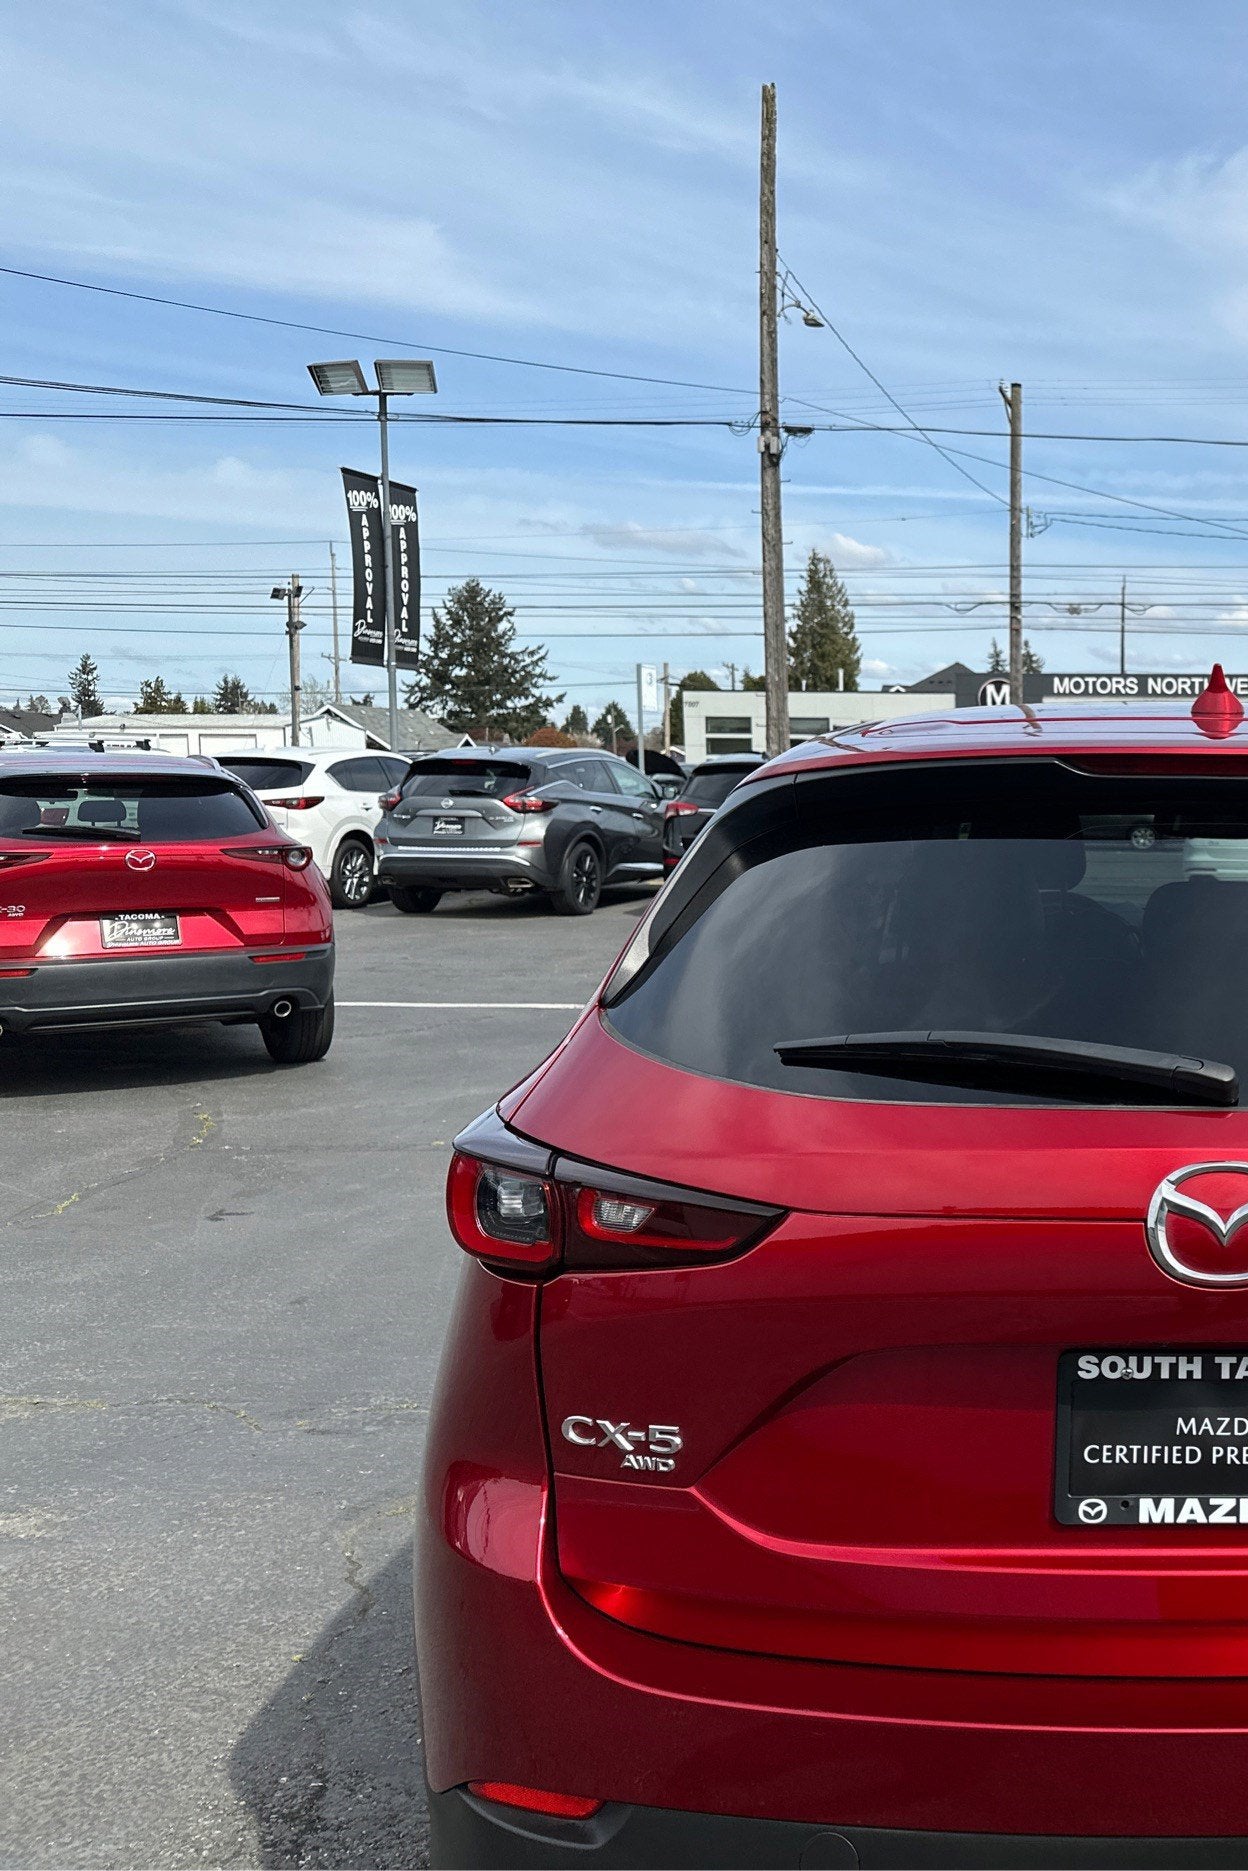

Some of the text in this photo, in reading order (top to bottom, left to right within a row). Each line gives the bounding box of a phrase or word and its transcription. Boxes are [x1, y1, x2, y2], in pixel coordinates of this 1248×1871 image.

[347, 489, 379, 509] 100%
[361, 514, 374, 623] APPROVAL
[399, 527, 410, 632] APPROVAL
[1053, 676, 1138, 695] MOTORS
[0, 905, 26, 913] -30
[119, 913, 161, 921] TACOMA
[1077, 1355, 1202, 1380] SOUTH
[561, 1415, 684, 1455] CX-5
[620, 1454, 676, 1472] AWD
[1083, 1445, 1202, 1464] CERTIFIED
